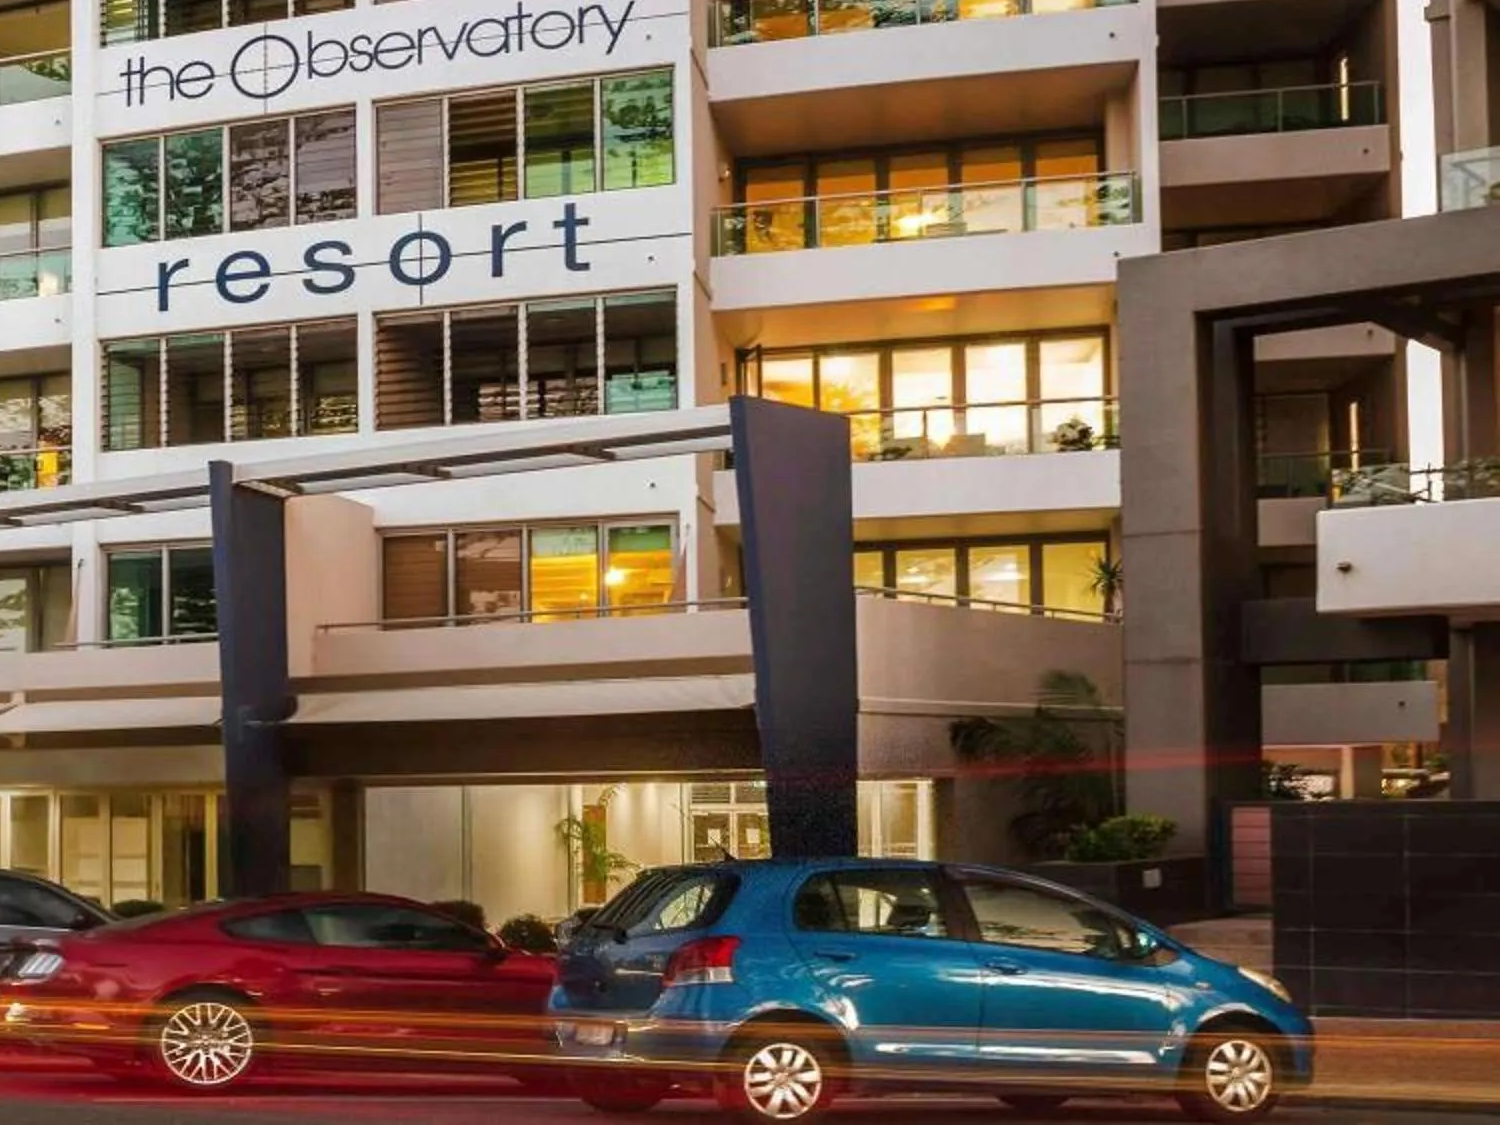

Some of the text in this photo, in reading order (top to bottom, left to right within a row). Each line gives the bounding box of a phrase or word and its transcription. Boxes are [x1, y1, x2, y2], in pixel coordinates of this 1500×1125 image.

[119, 0, 636, 107] the Observatory
[157, 201, 591, 313] resort
